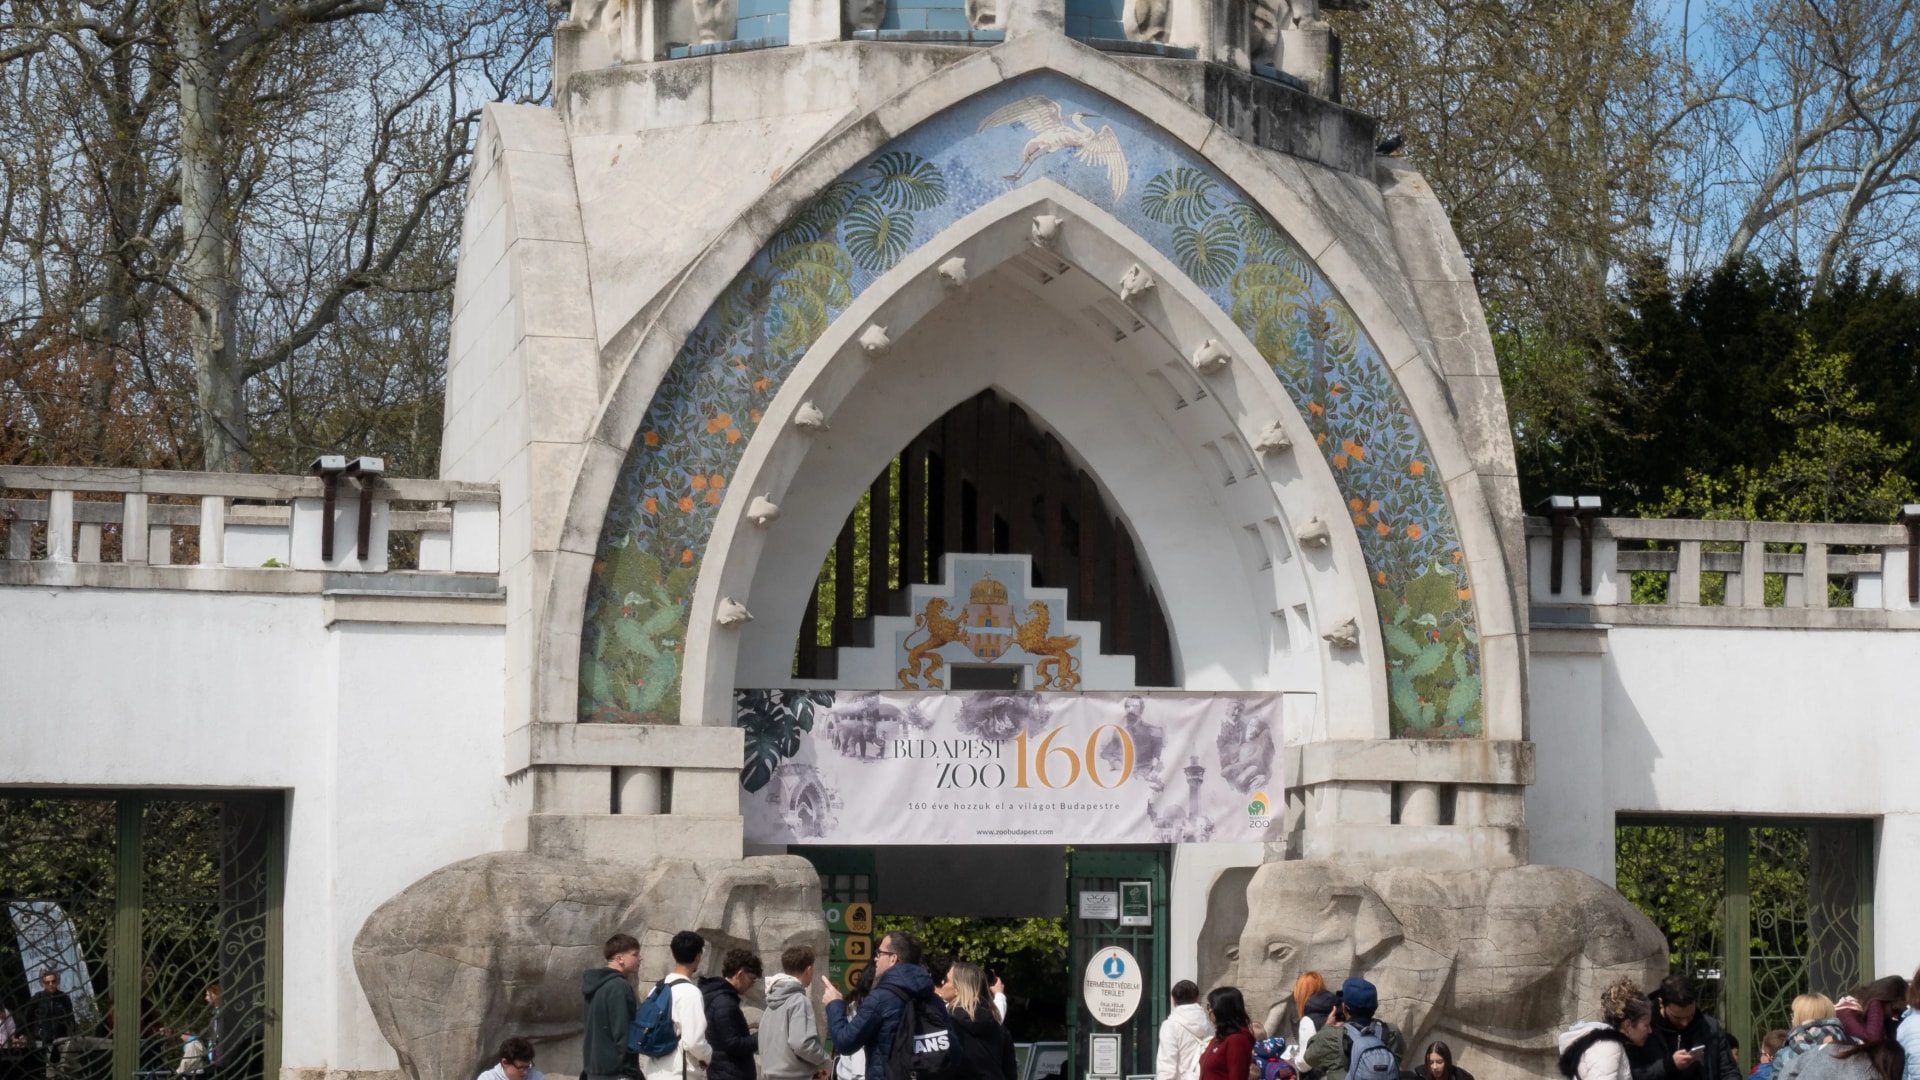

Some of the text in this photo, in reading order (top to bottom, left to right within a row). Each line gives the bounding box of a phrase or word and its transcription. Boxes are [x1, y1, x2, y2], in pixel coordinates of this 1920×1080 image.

[893, 739, 1006, 759] BUDAPEST
[1011, 724, 1135, 789] 160
[936, 762, 1006, 789] ZOO
[908, 802, 928, 810] 160
[931, 801, 950, 810] éve
[953, 801, 991, 810] hozzuk
[995, 801, 1005, 810] el
[1018, 801, 1056, 812] világot
[1060, 801, 1121, 811] Budapestre
[1249, 820, 1270, 828] ZOO
[976, 828, 1054, 836] www.zoobudapest.com
